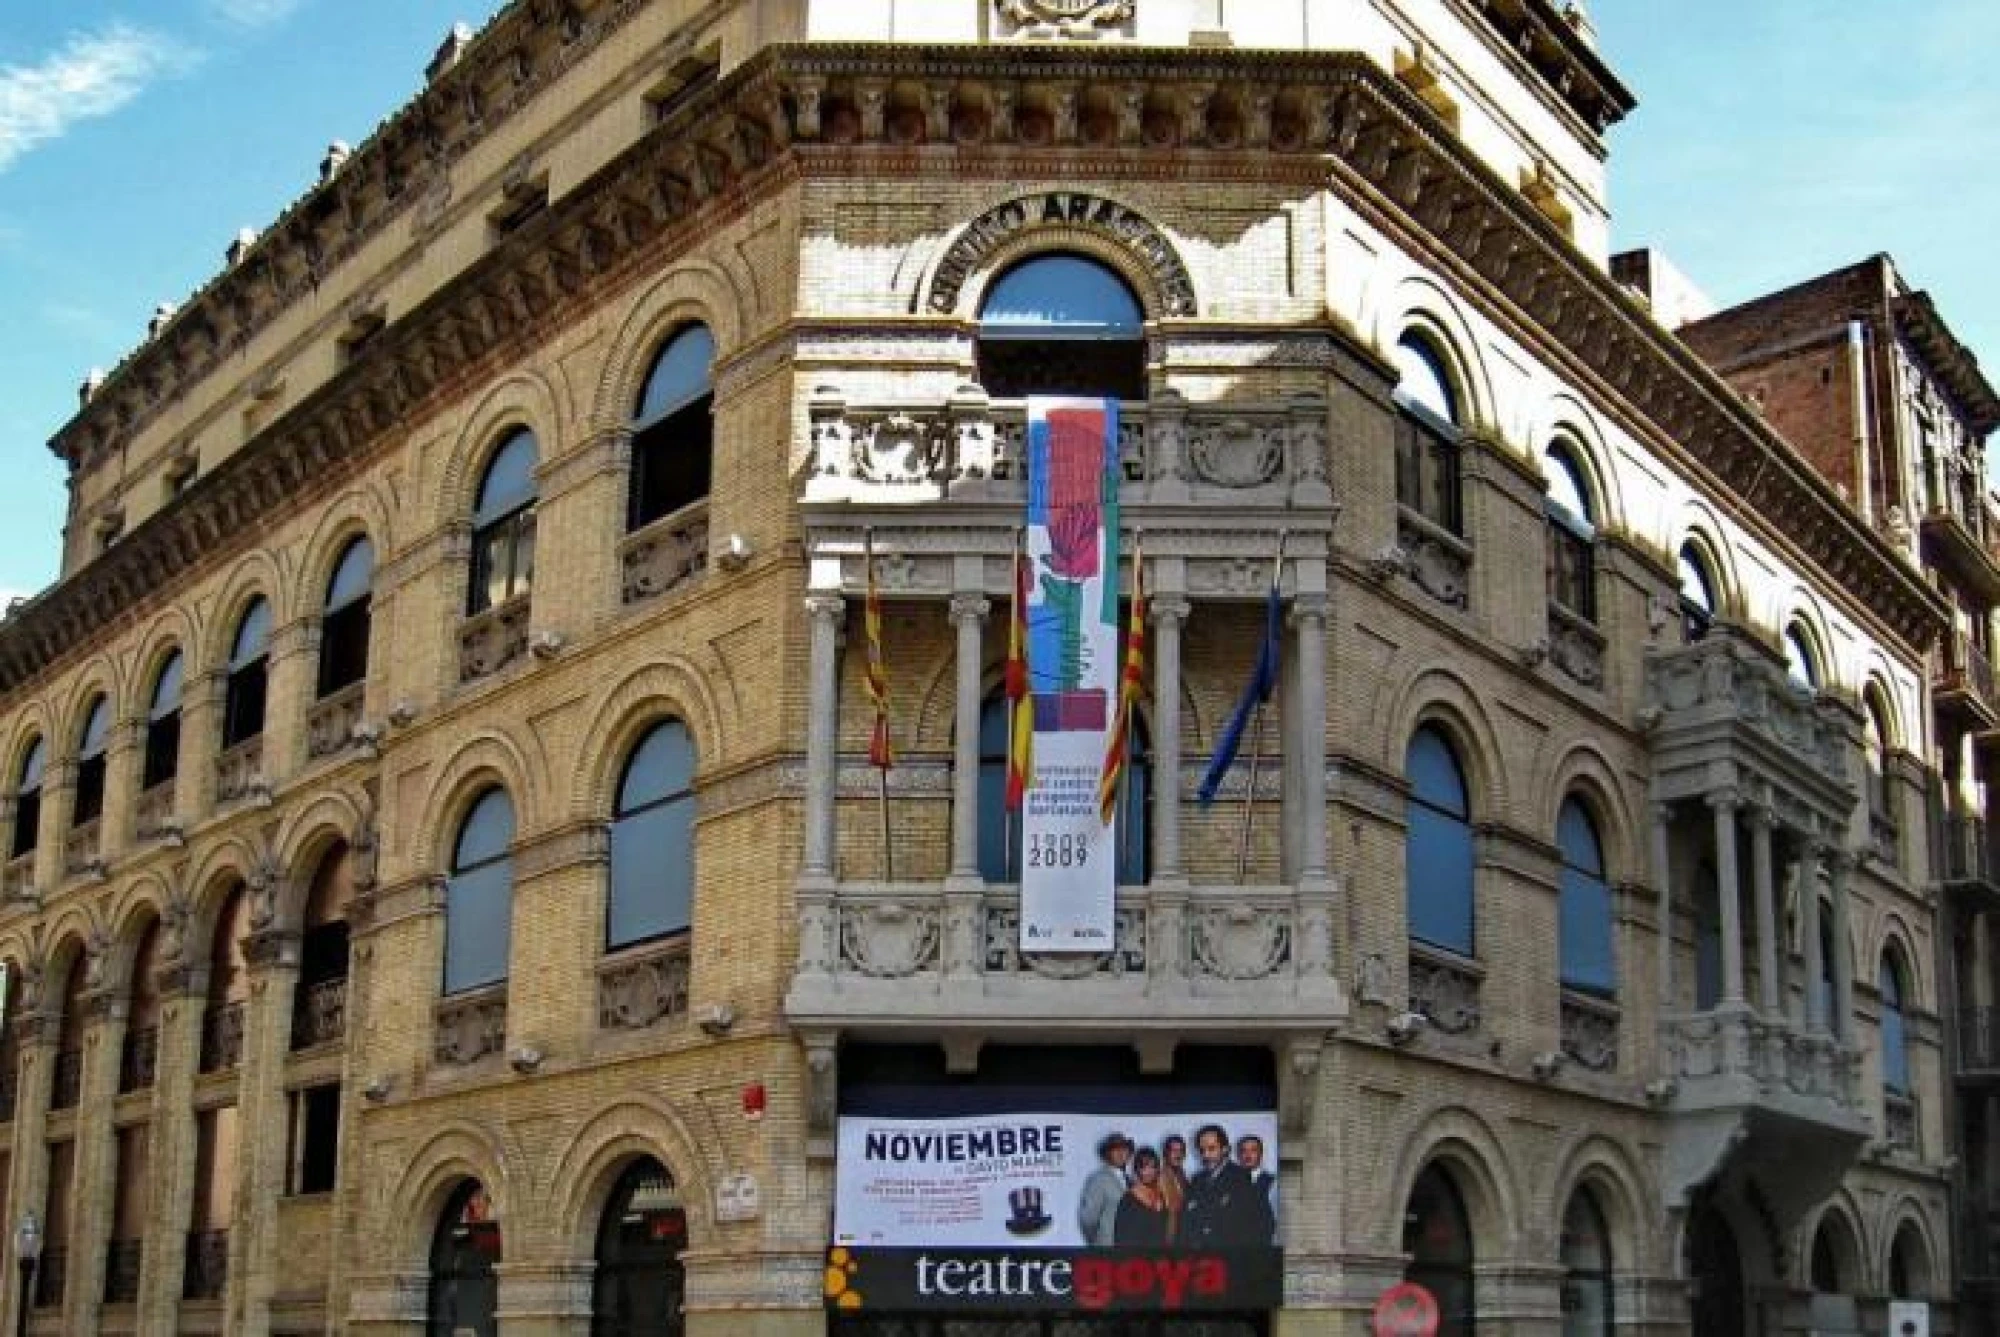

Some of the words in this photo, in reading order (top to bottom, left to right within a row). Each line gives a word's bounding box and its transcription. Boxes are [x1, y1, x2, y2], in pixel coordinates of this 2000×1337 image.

[1028, 848, 1088, 867] 2009
[864, 1125, 1064, 1163] NOVIEMBRE
[916, 1255, 1072, 1296] teatre
[1072, 1256, 1228, 1310] goya
